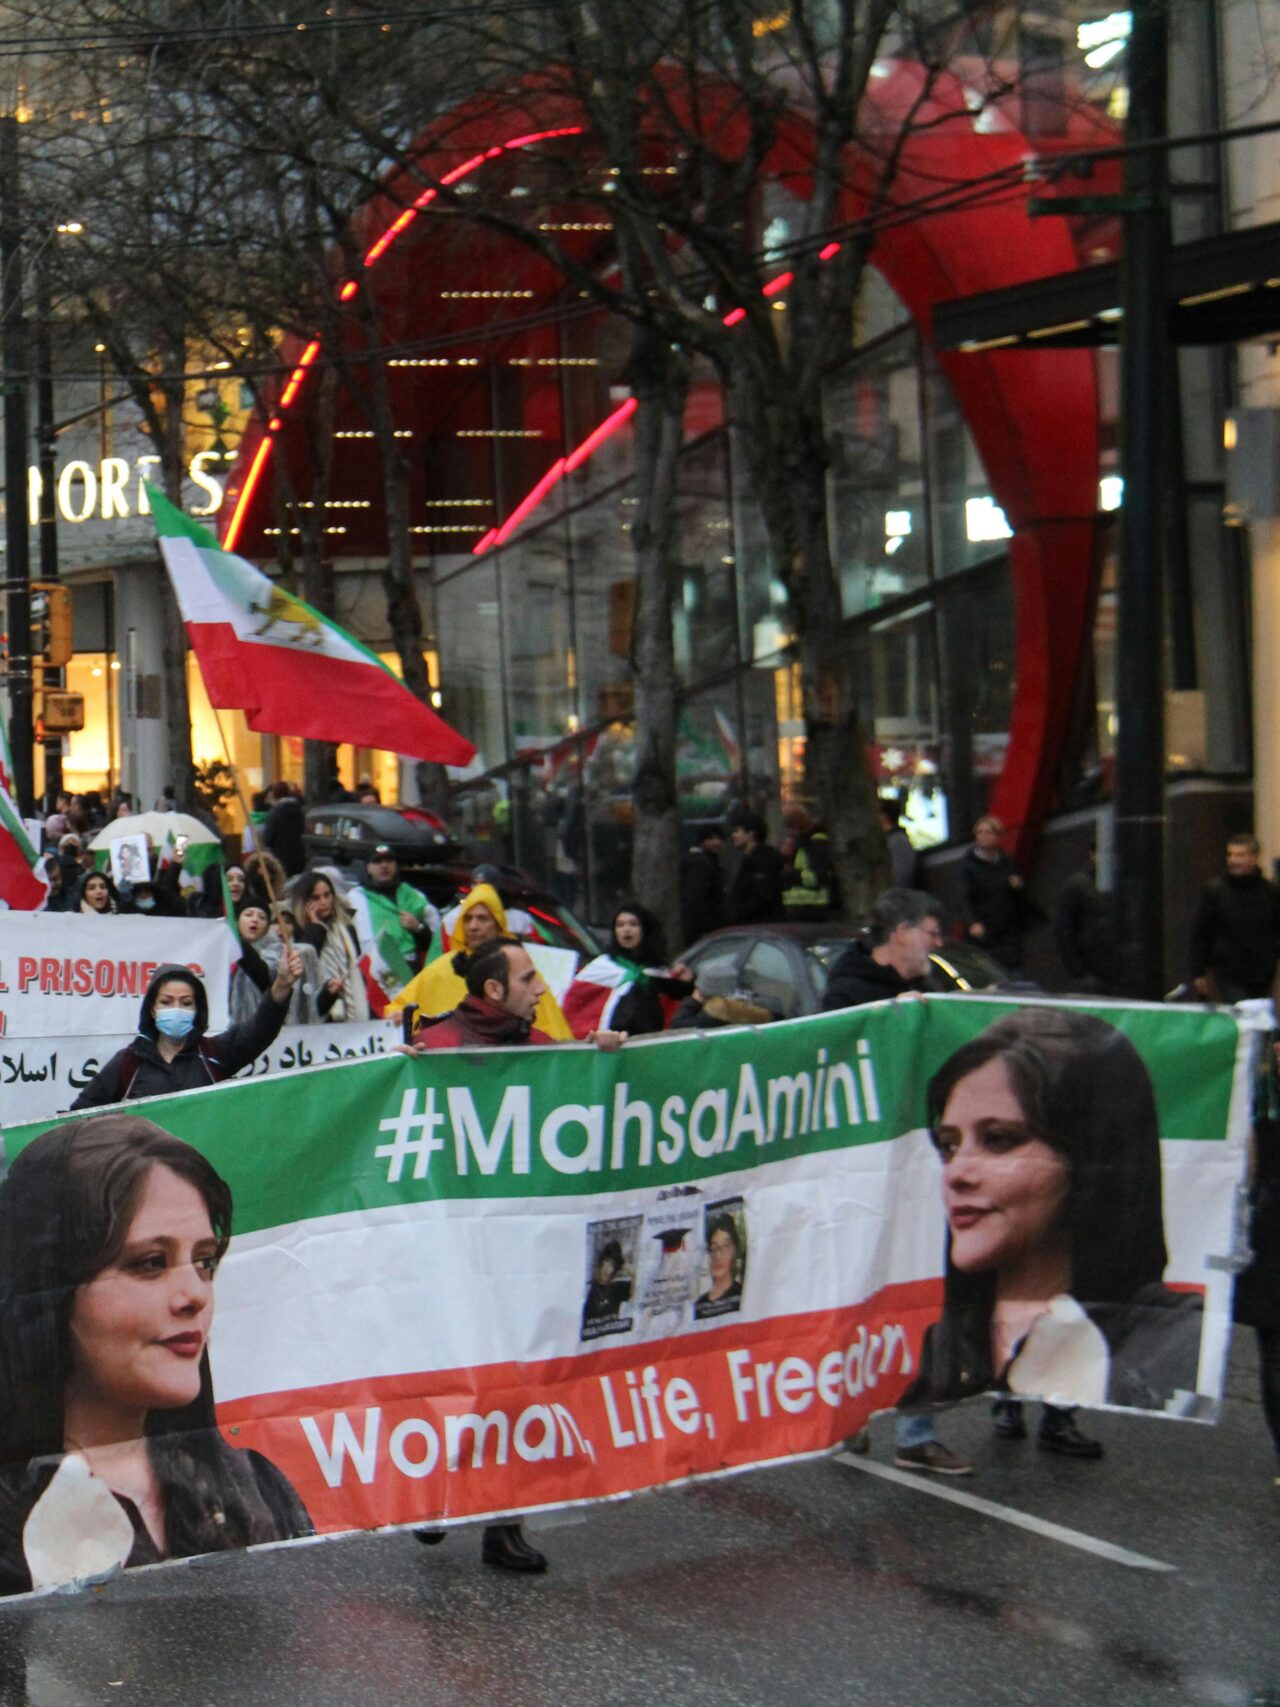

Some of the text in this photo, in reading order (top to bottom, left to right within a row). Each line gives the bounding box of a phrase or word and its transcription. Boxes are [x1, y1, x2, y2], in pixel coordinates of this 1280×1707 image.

[18, 956, 204, 998] PRISONE
[374, 1038, 881, 1183] #MahsaAmini
[299, 1402, 597, 1488] Woman,
[599, 1365, 716, 1449] Life,
